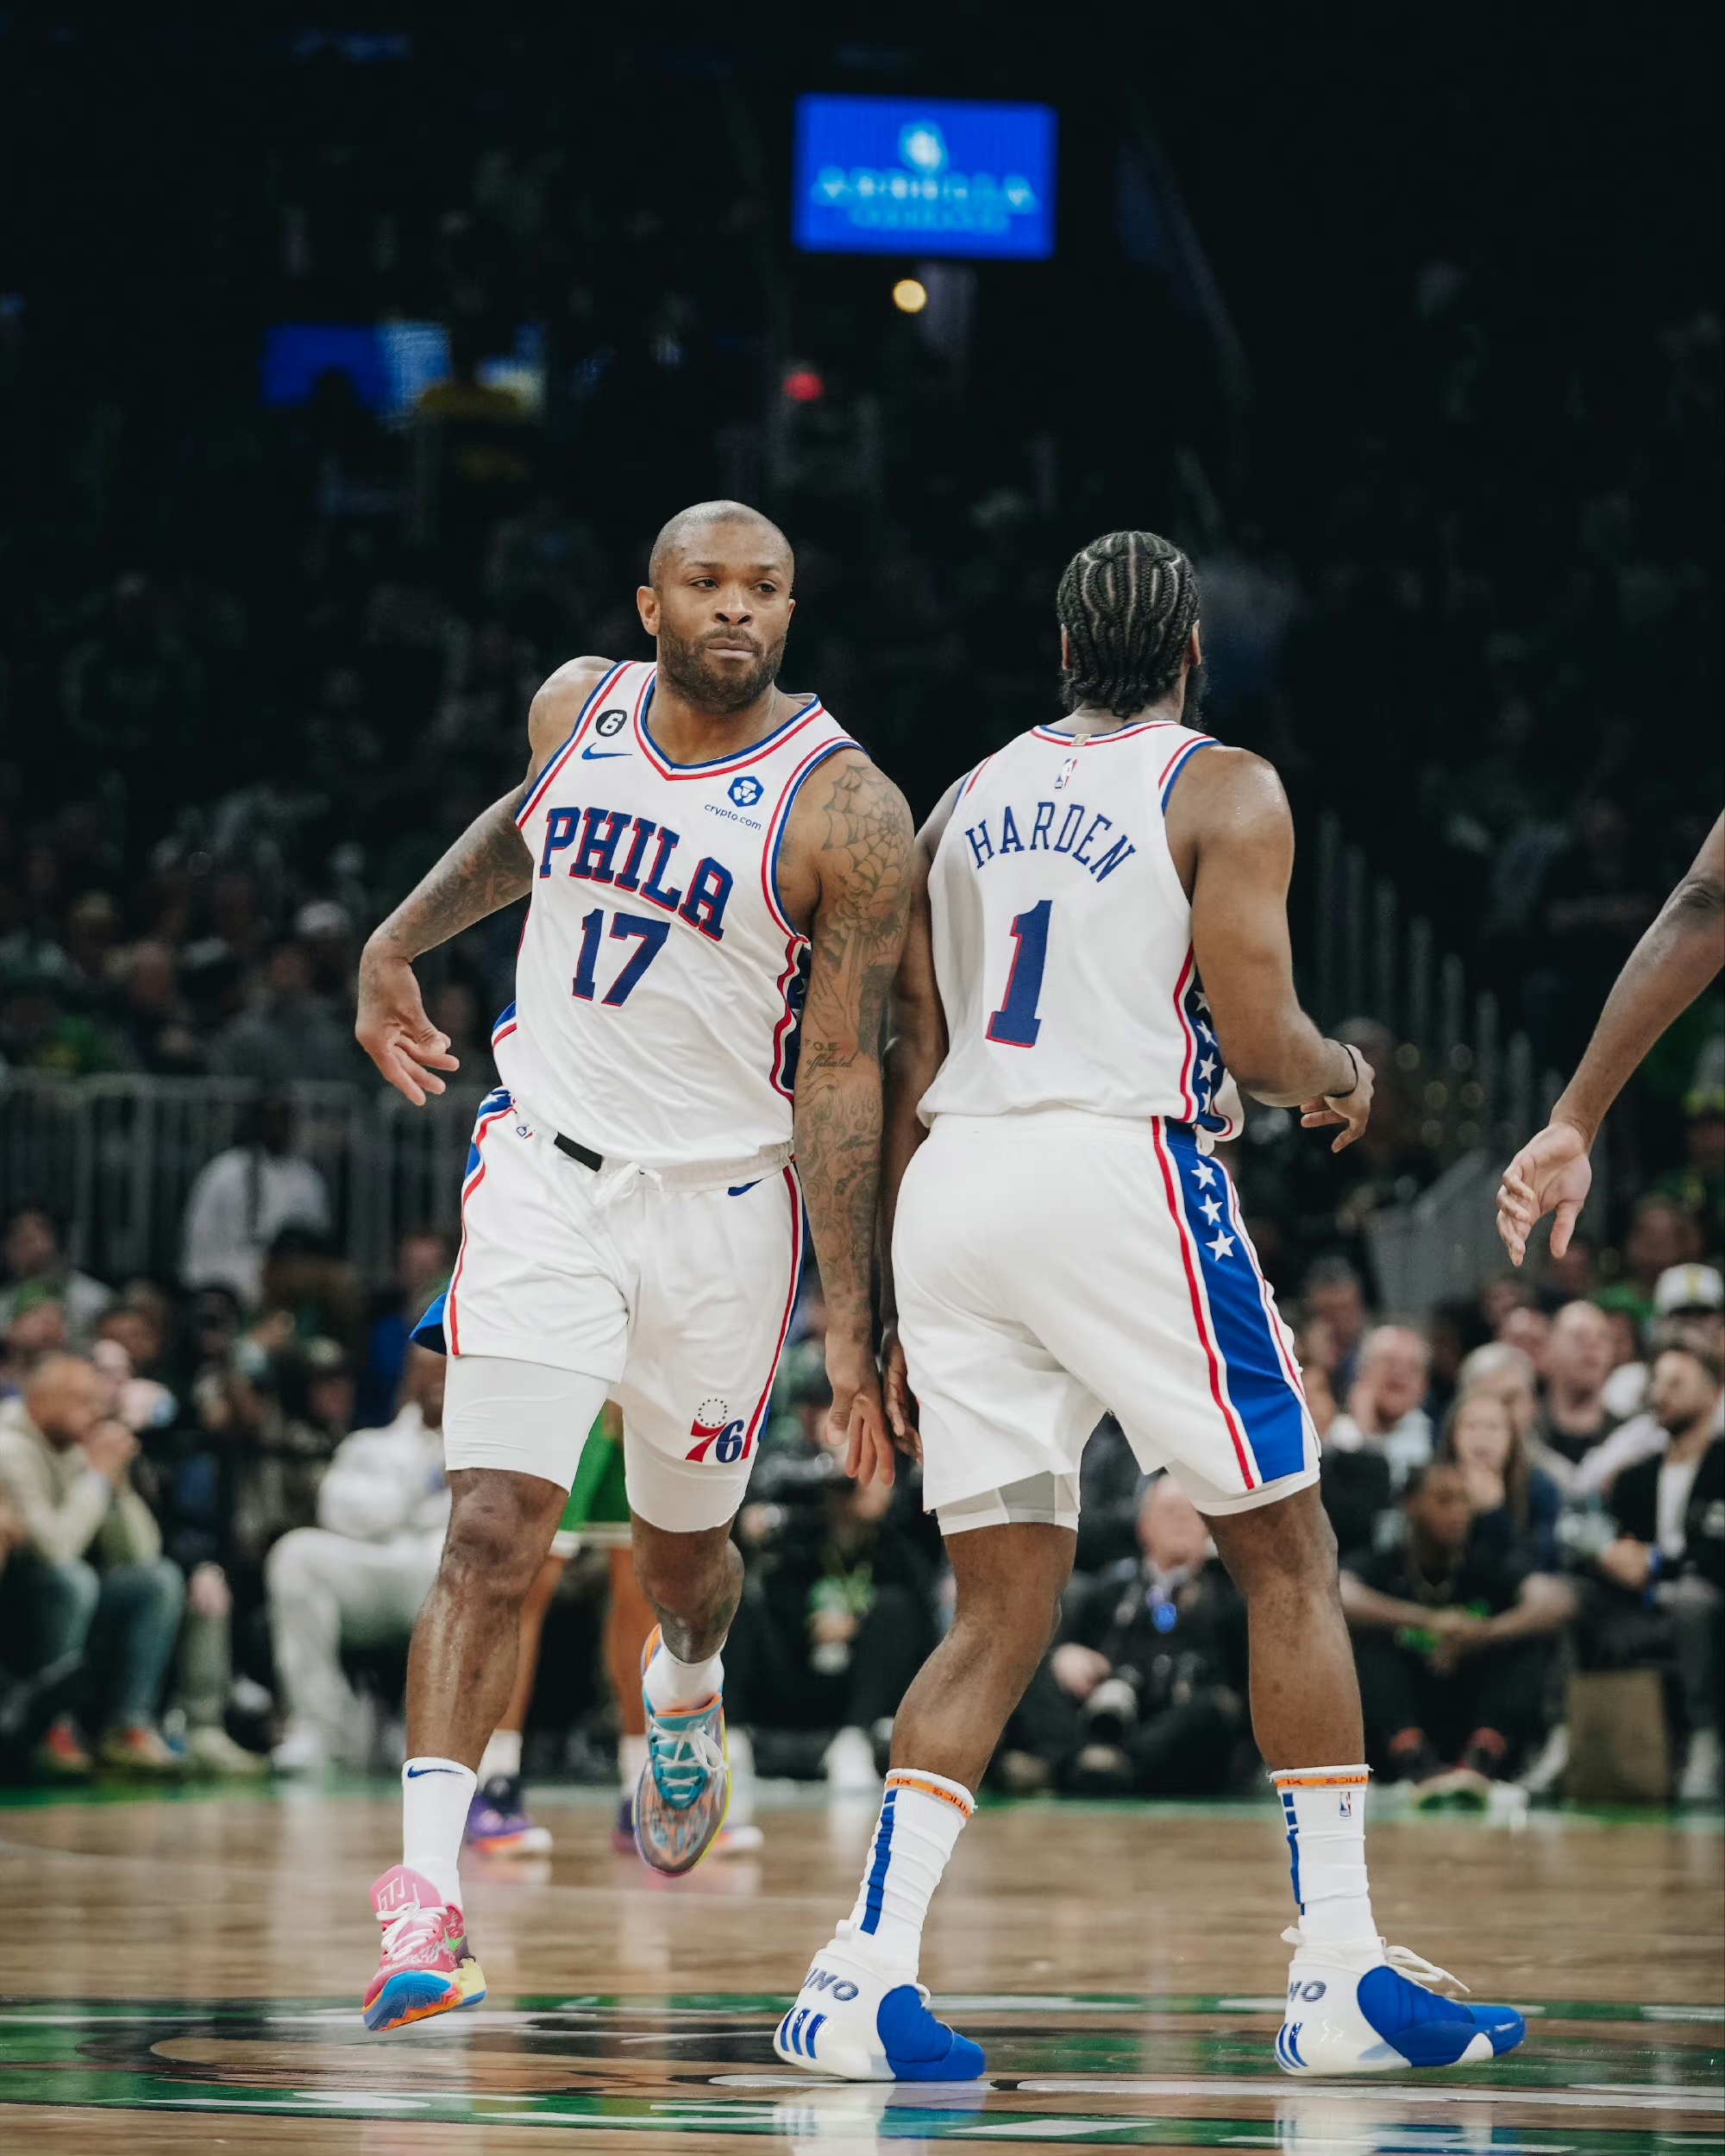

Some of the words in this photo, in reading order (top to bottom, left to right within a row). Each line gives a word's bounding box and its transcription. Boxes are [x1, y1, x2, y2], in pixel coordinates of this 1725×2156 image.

[600, 713, 624, 734] 6
[705, 804, 762, 831] crypto.com
[965, 801, 1136, 883] HARDEN
[540, 807, 734, 941] PHILA
[573, 908, 671, 1007] 17
[985, 900, 1053, 1048] 1
[685, 1418, 744, 1463] 76
